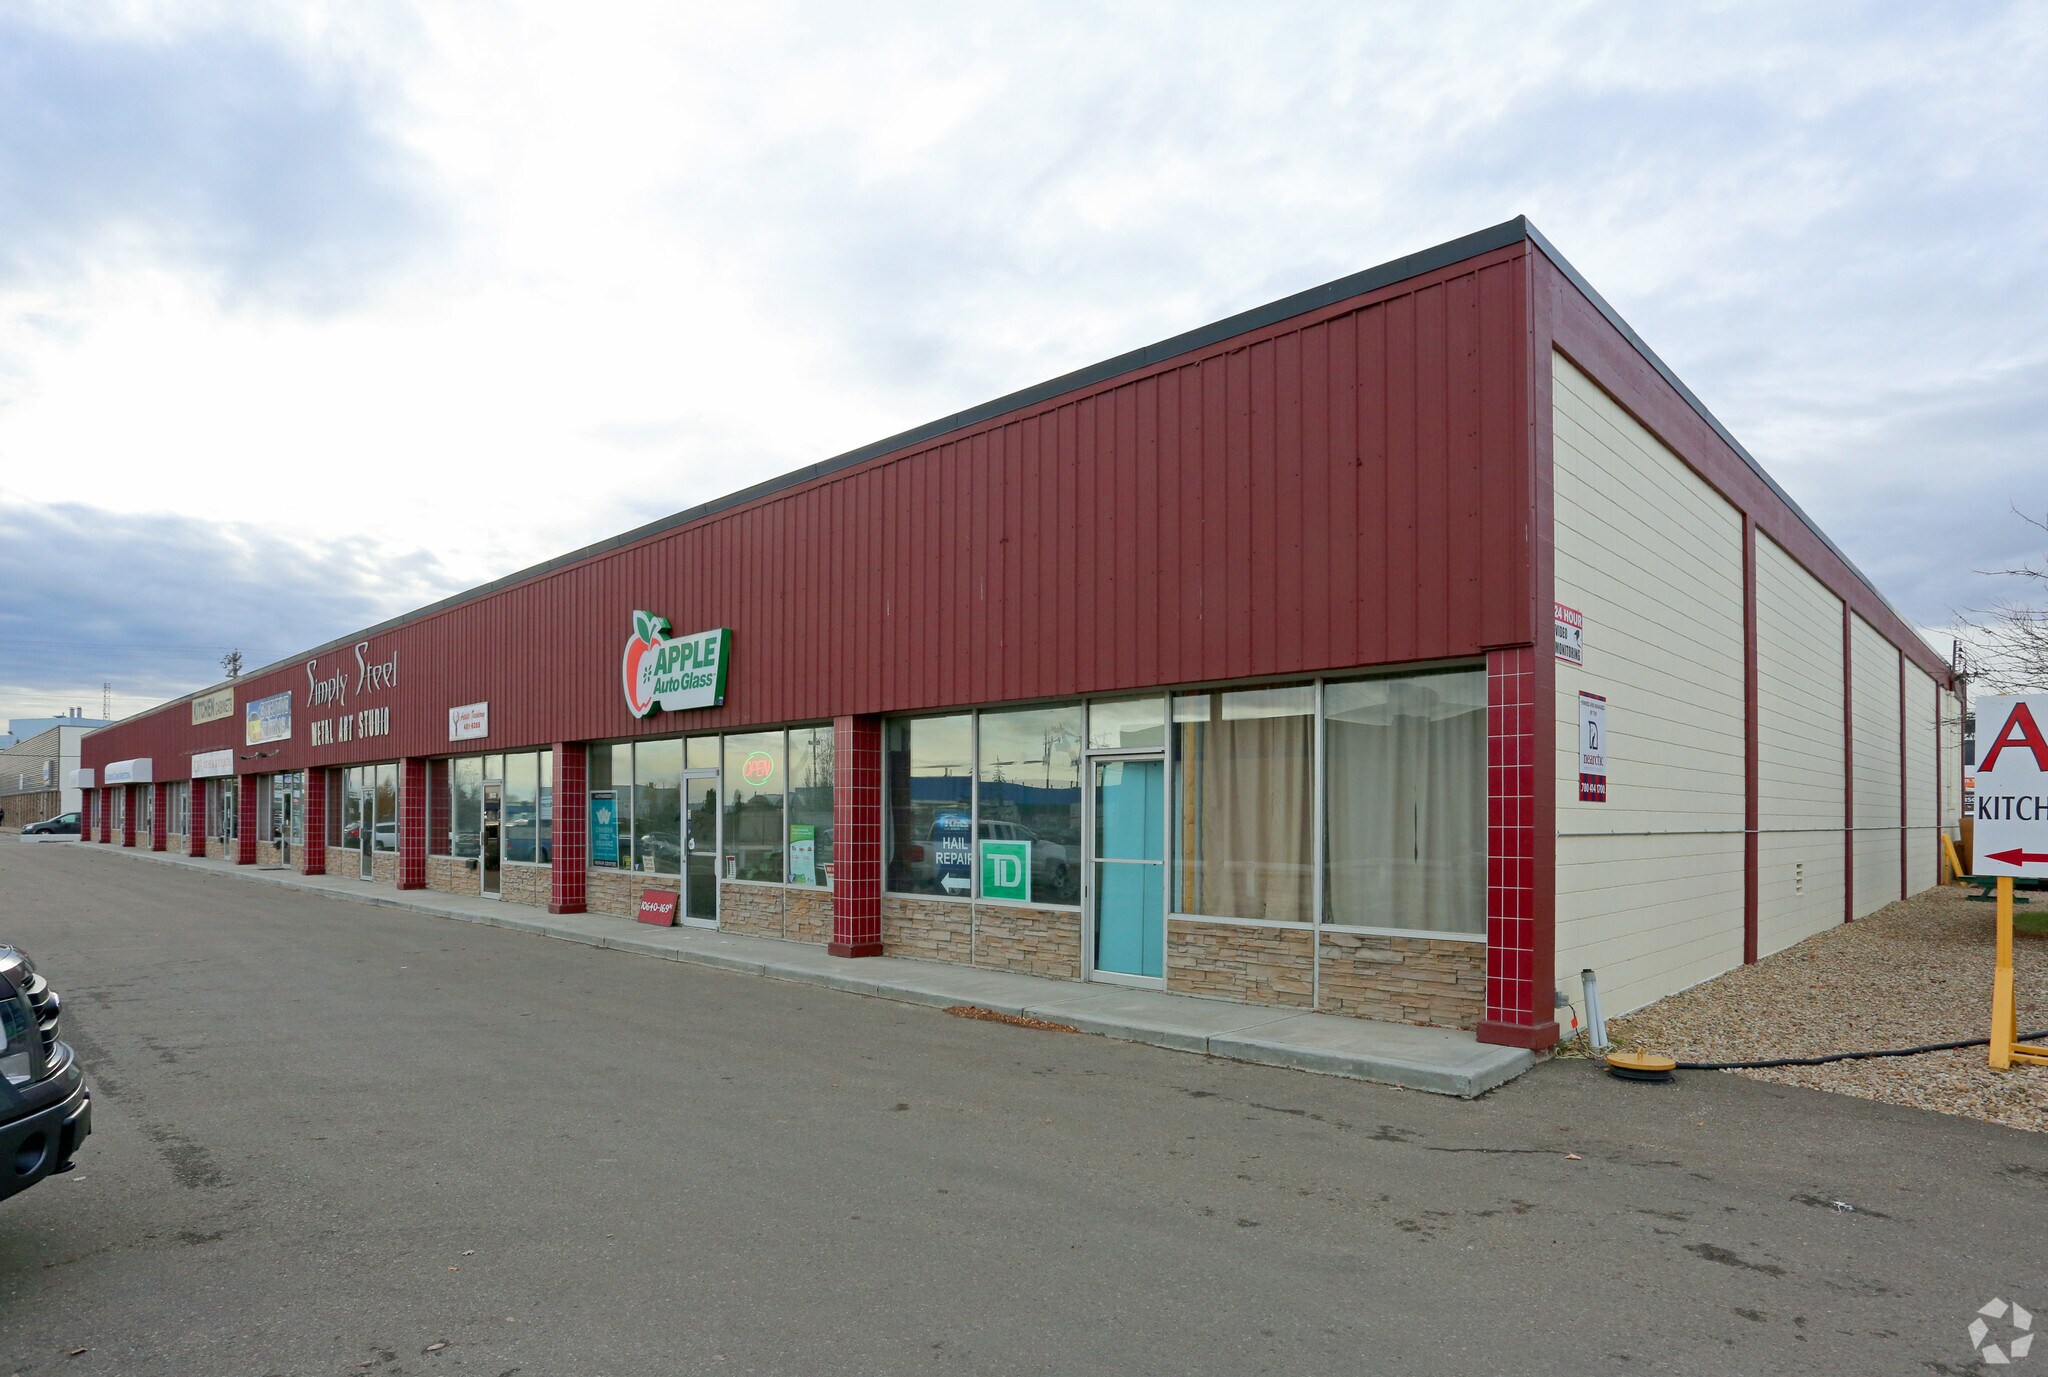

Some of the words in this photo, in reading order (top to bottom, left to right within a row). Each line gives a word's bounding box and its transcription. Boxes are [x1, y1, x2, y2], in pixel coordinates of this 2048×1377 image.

[1555, 605, 1562, 619] 24
[1564, 609, 1582, 627] HOUR
[653, 637, 717, 676] APPLE
[307, 660, 348, 709] Simply
[355, 641, 397, 696] Steel
[653, 676, 680, 695] Auto
[681, 672, 713, 691] Glass
[311, 719, 334, 747] METAL
[338, 714, 354, 743] ART
[358, 706, 390, 740] STUDIO
[744, 760, 771, 777] OPEN
[942, 837, 969, 850] HAIL
[986, 853, 1023, 888] TD
